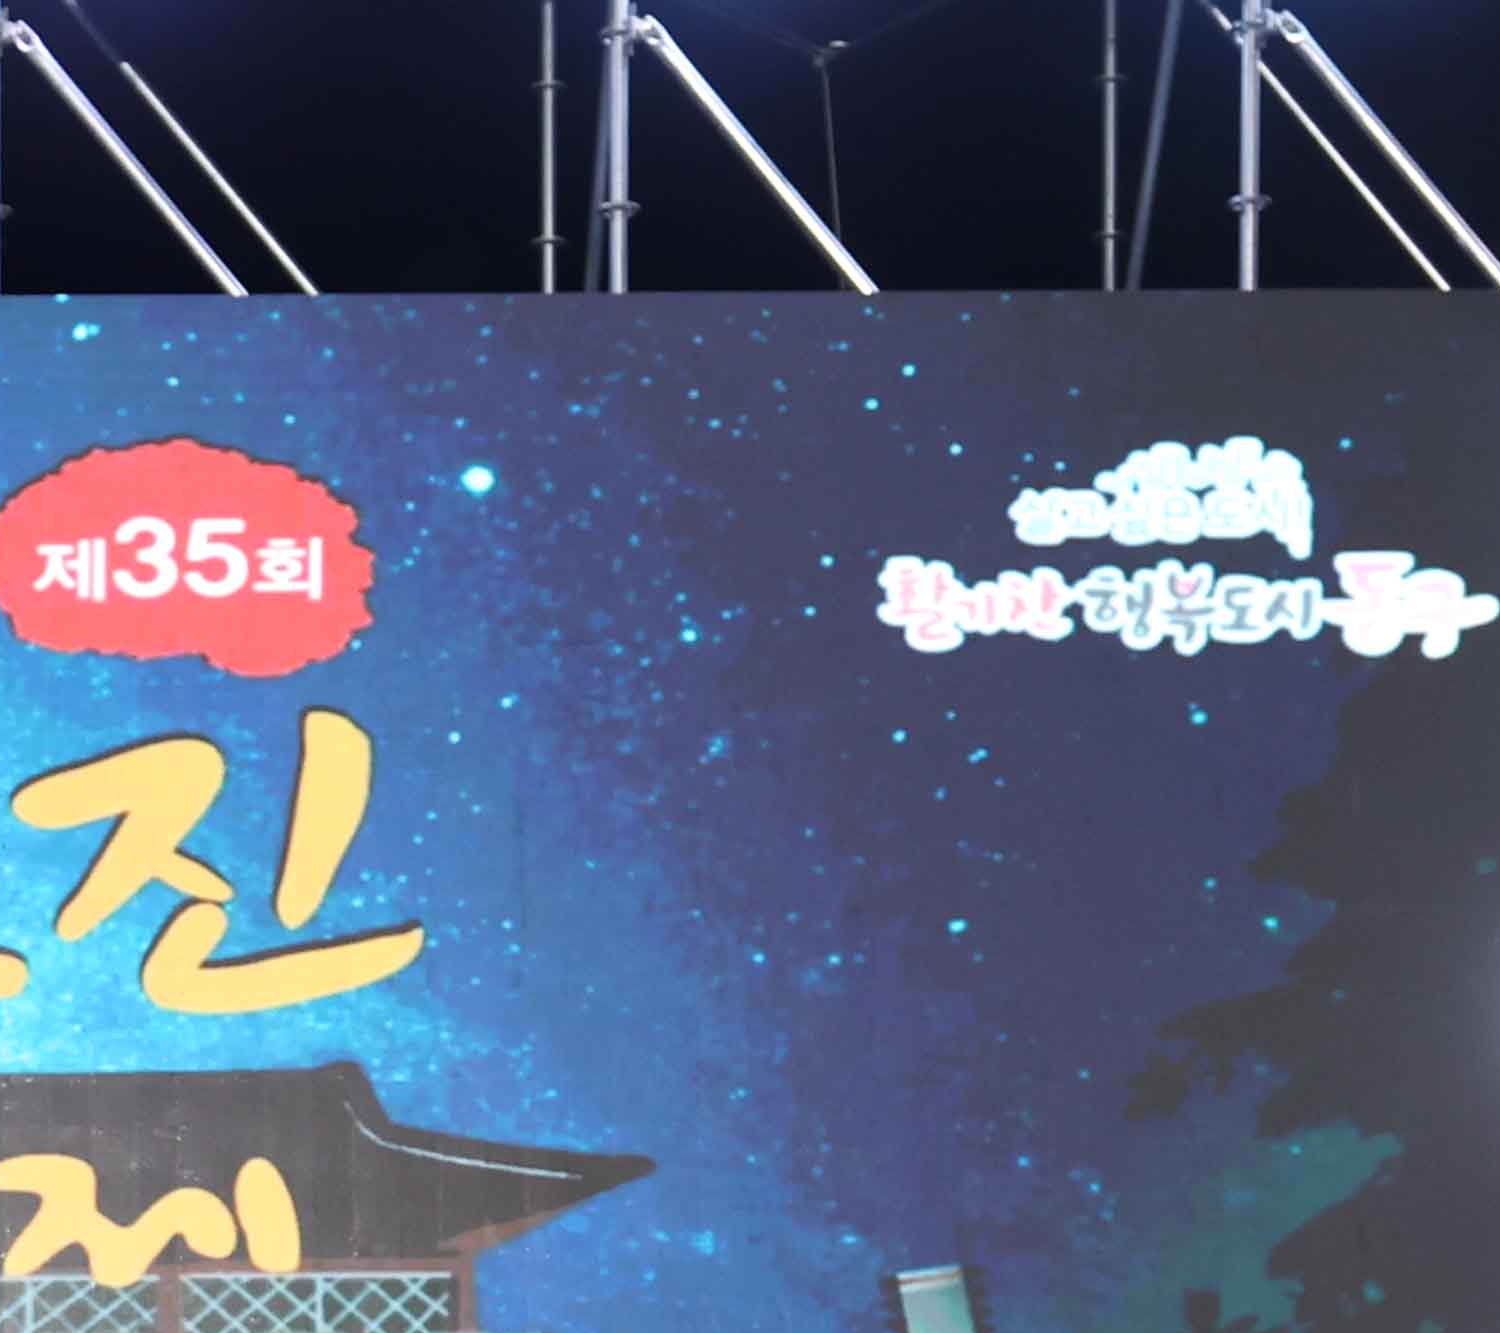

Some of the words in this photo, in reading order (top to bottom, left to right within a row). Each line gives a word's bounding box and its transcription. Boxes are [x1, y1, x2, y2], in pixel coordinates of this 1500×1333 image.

[32, 514, 324, 603] 제35회
[886, 560, 1068, 648] 활기찬
[1081, 566, 1319, 649] 행복도시
